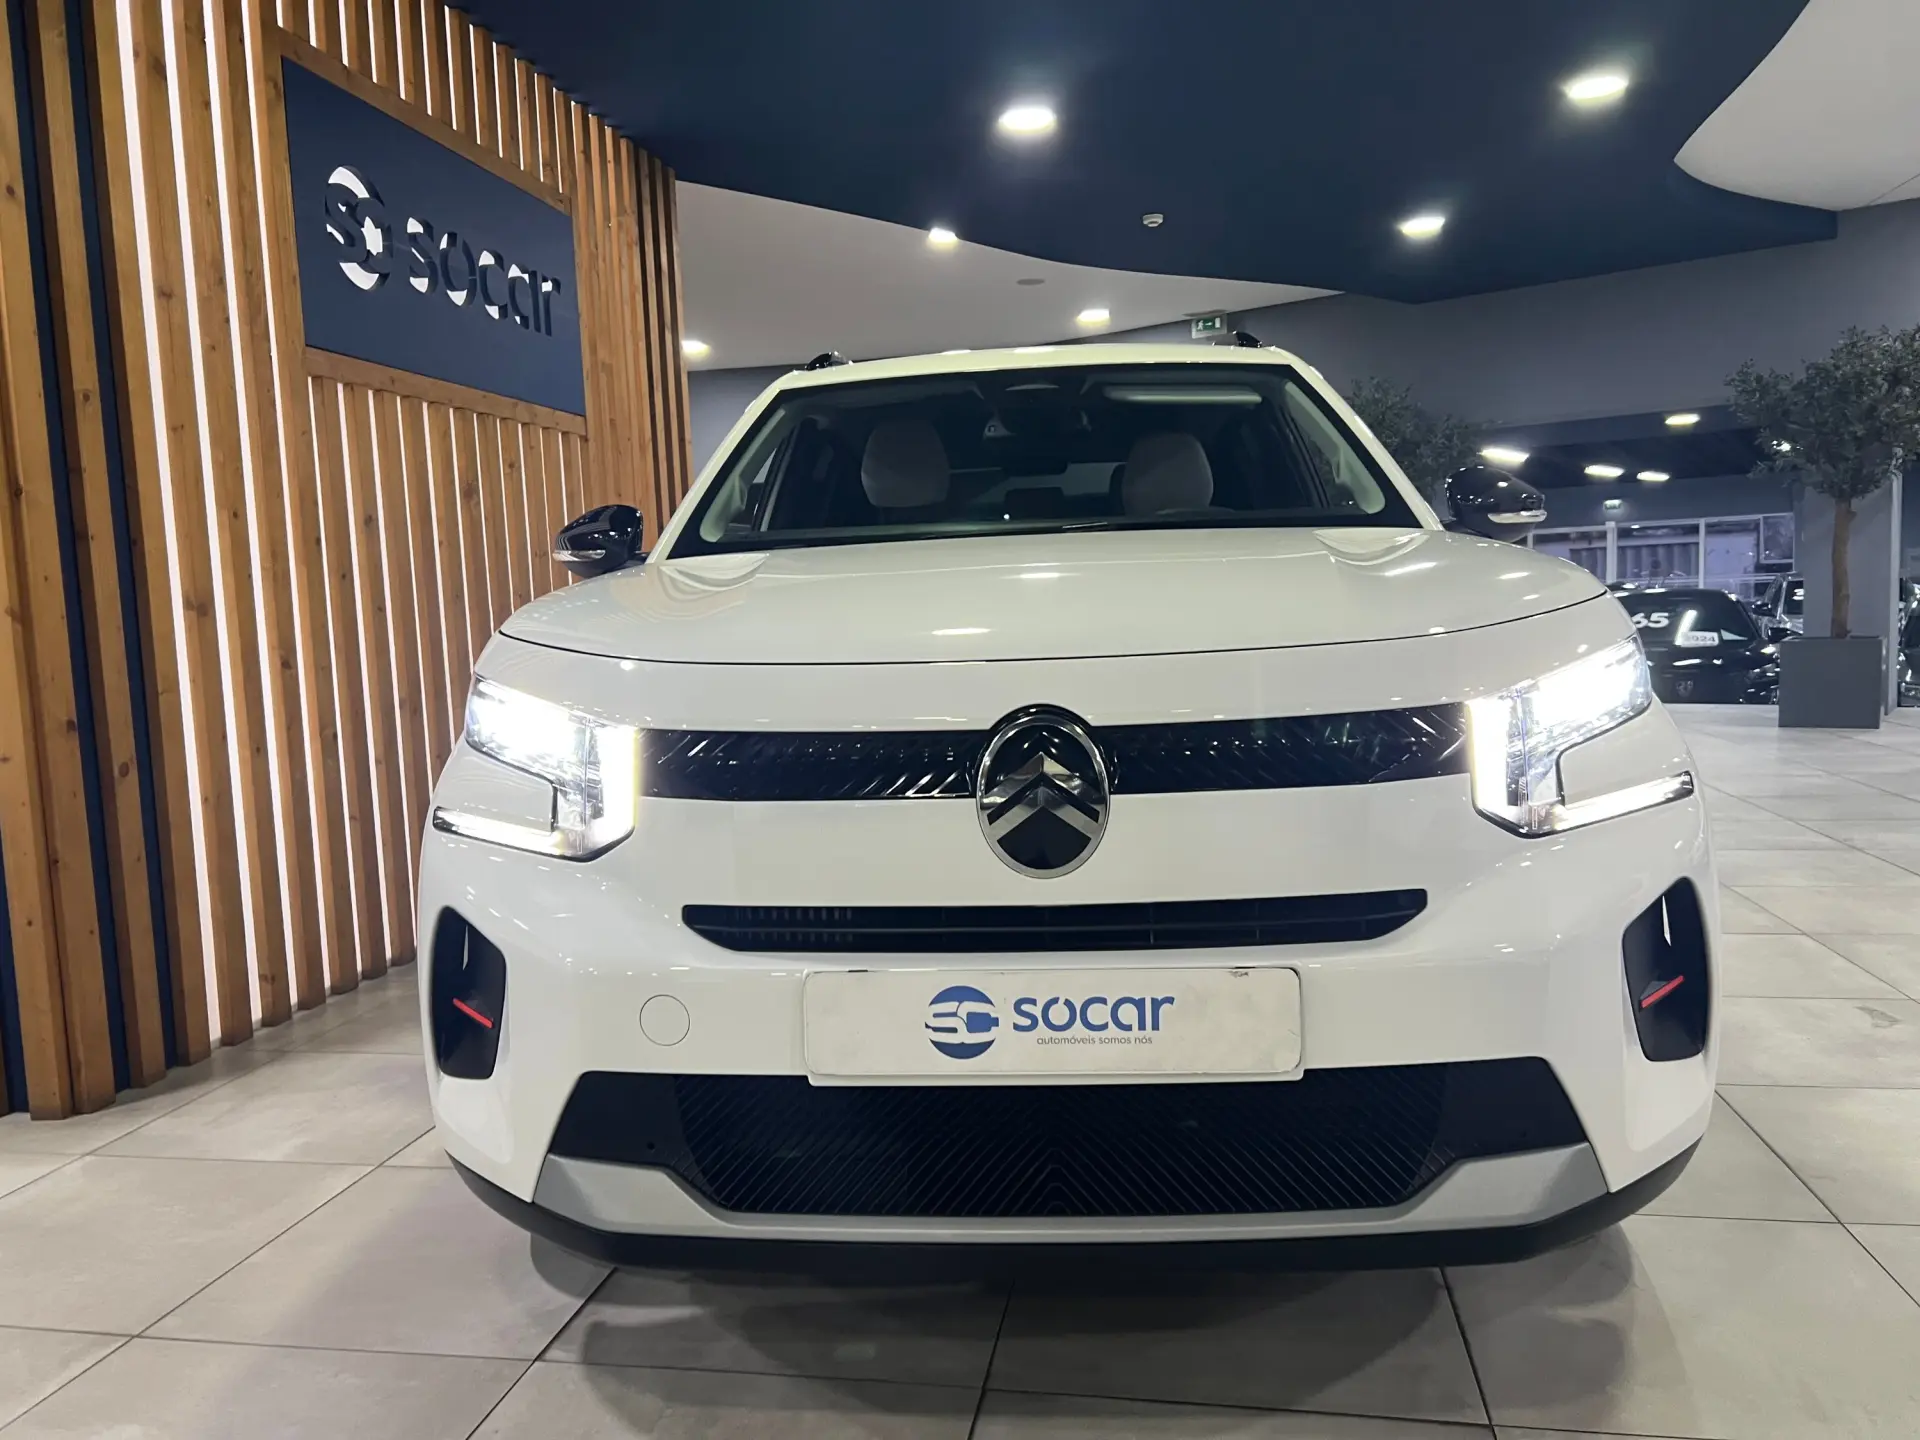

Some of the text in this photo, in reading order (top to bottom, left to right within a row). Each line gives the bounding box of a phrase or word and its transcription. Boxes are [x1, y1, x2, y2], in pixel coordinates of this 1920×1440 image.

[406, 217, 561, 336] socar
[1012, 996, 1176, 1032] socar
[1036, 1035, 1153, 1045] automóveis somos nós
